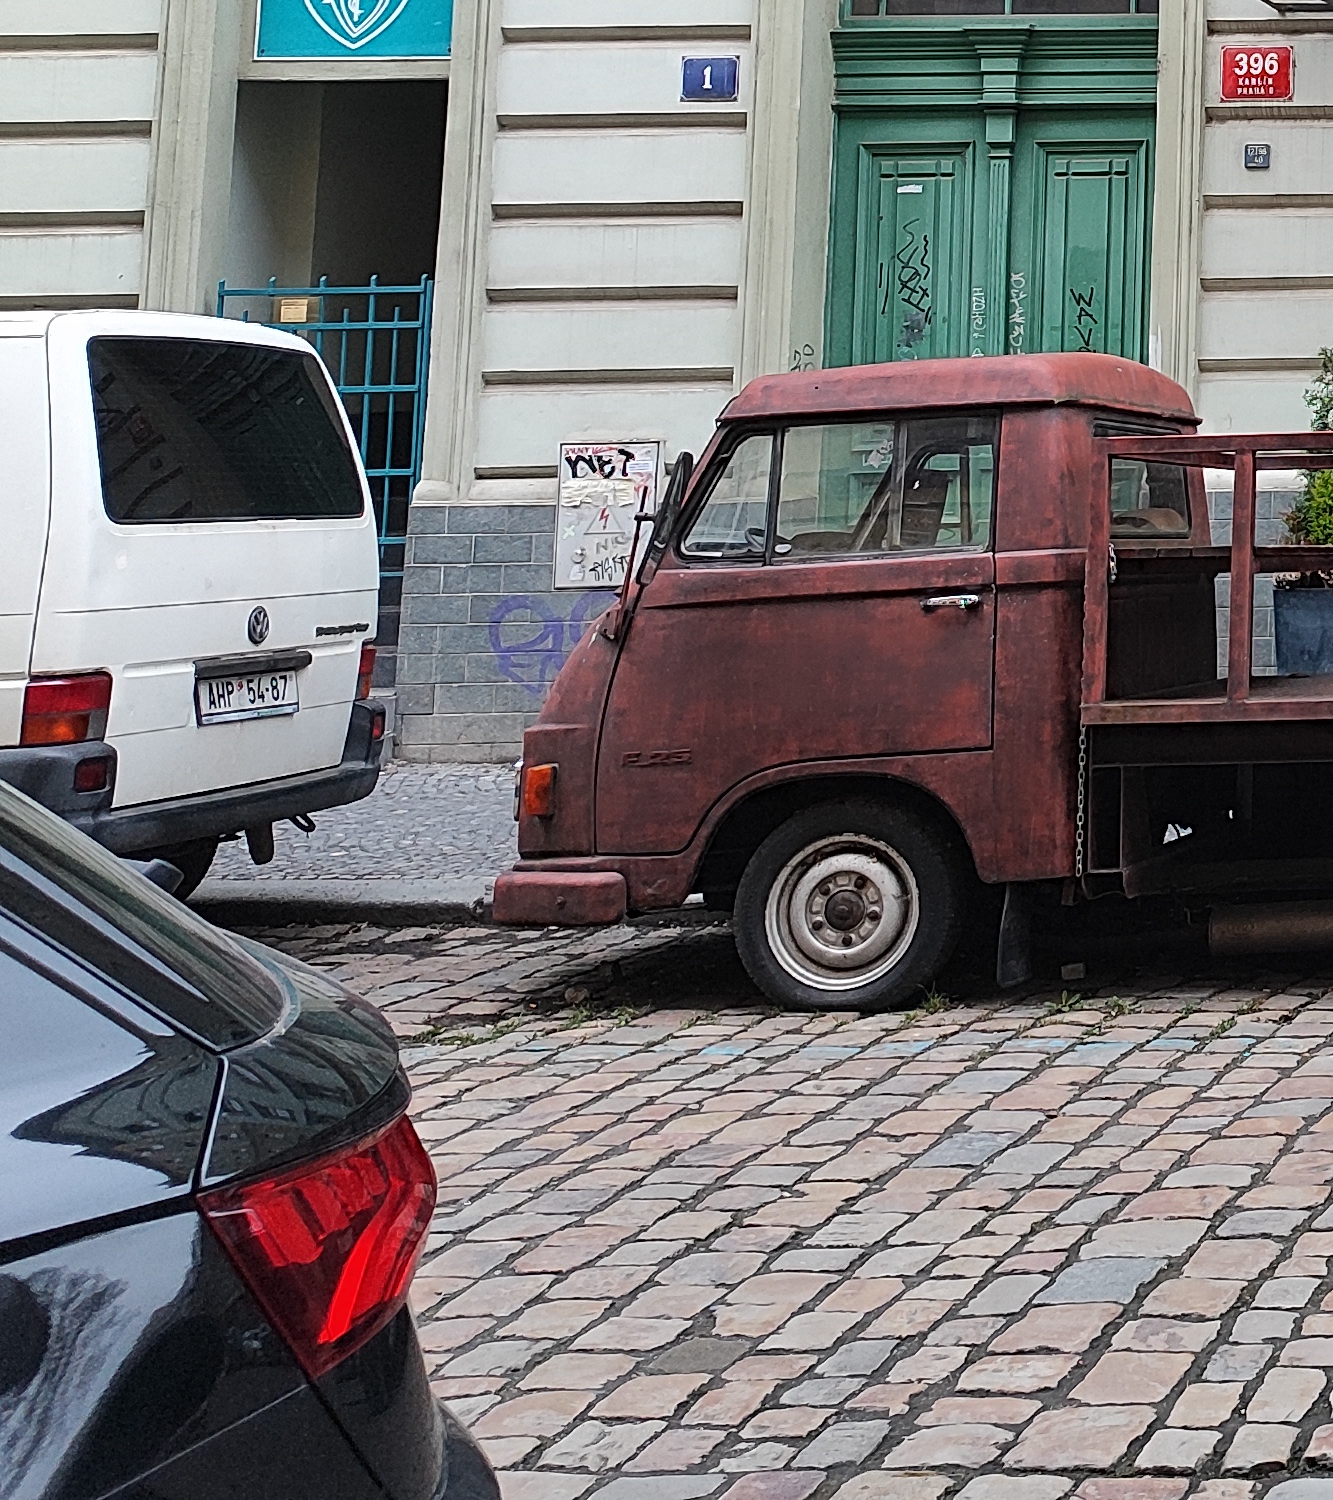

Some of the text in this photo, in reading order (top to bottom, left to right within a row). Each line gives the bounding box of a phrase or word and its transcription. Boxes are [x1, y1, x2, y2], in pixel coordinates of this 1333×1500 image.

[1233, 52, 1279, 76] 396
[702, 65, 713, 90] 1
[208, 674, 288, 710] AHP 54-87
